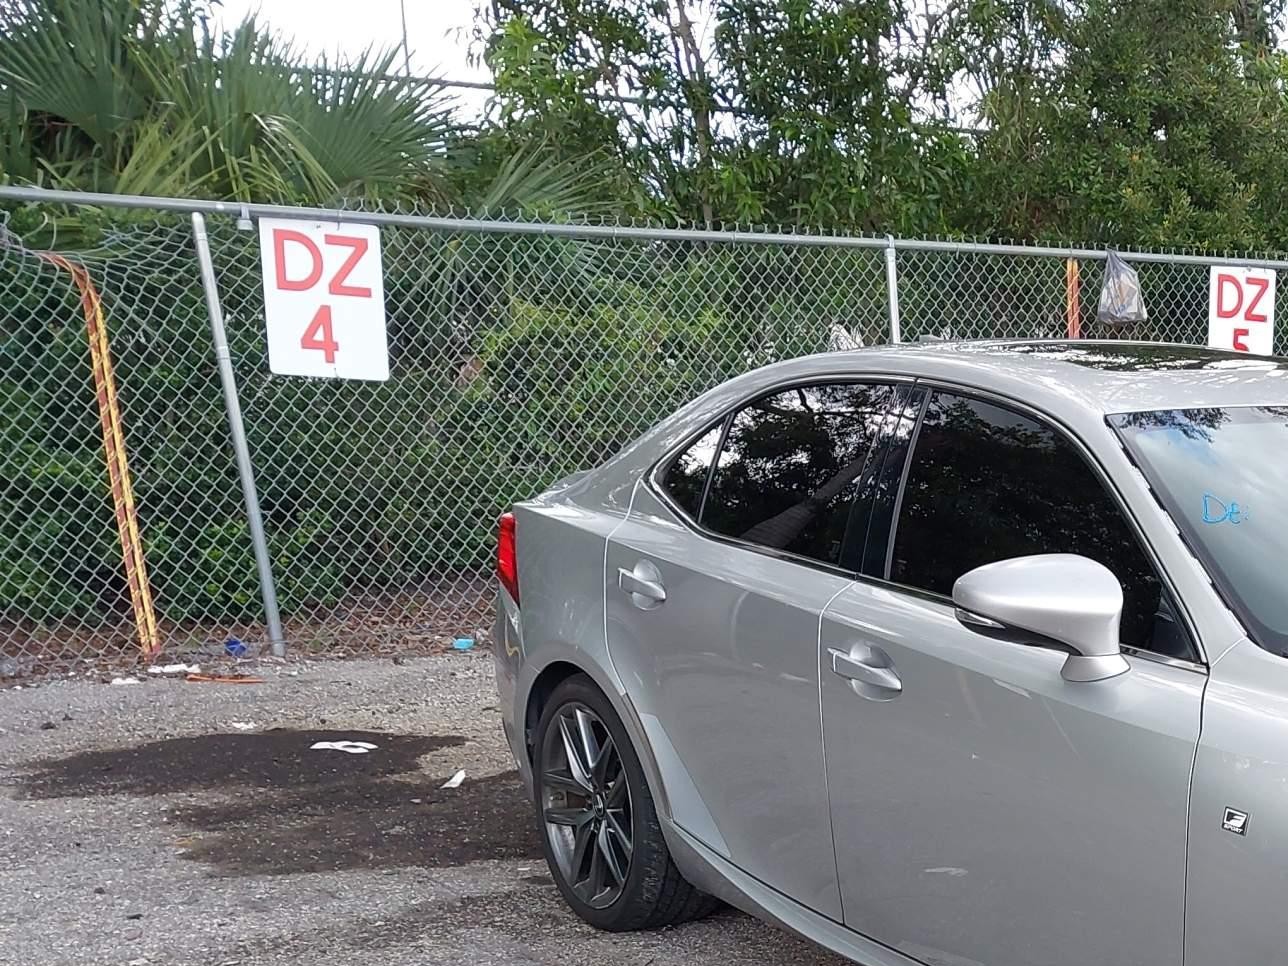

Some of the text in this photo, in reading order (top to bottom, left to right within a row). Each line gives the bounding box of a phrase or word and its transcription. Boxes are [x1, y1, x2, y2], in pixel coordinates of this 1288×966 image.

[273, 229, 372, 298] DZ
[1217, 273, 1270, 323] DZ
[301, 305, 339, 364] 4
